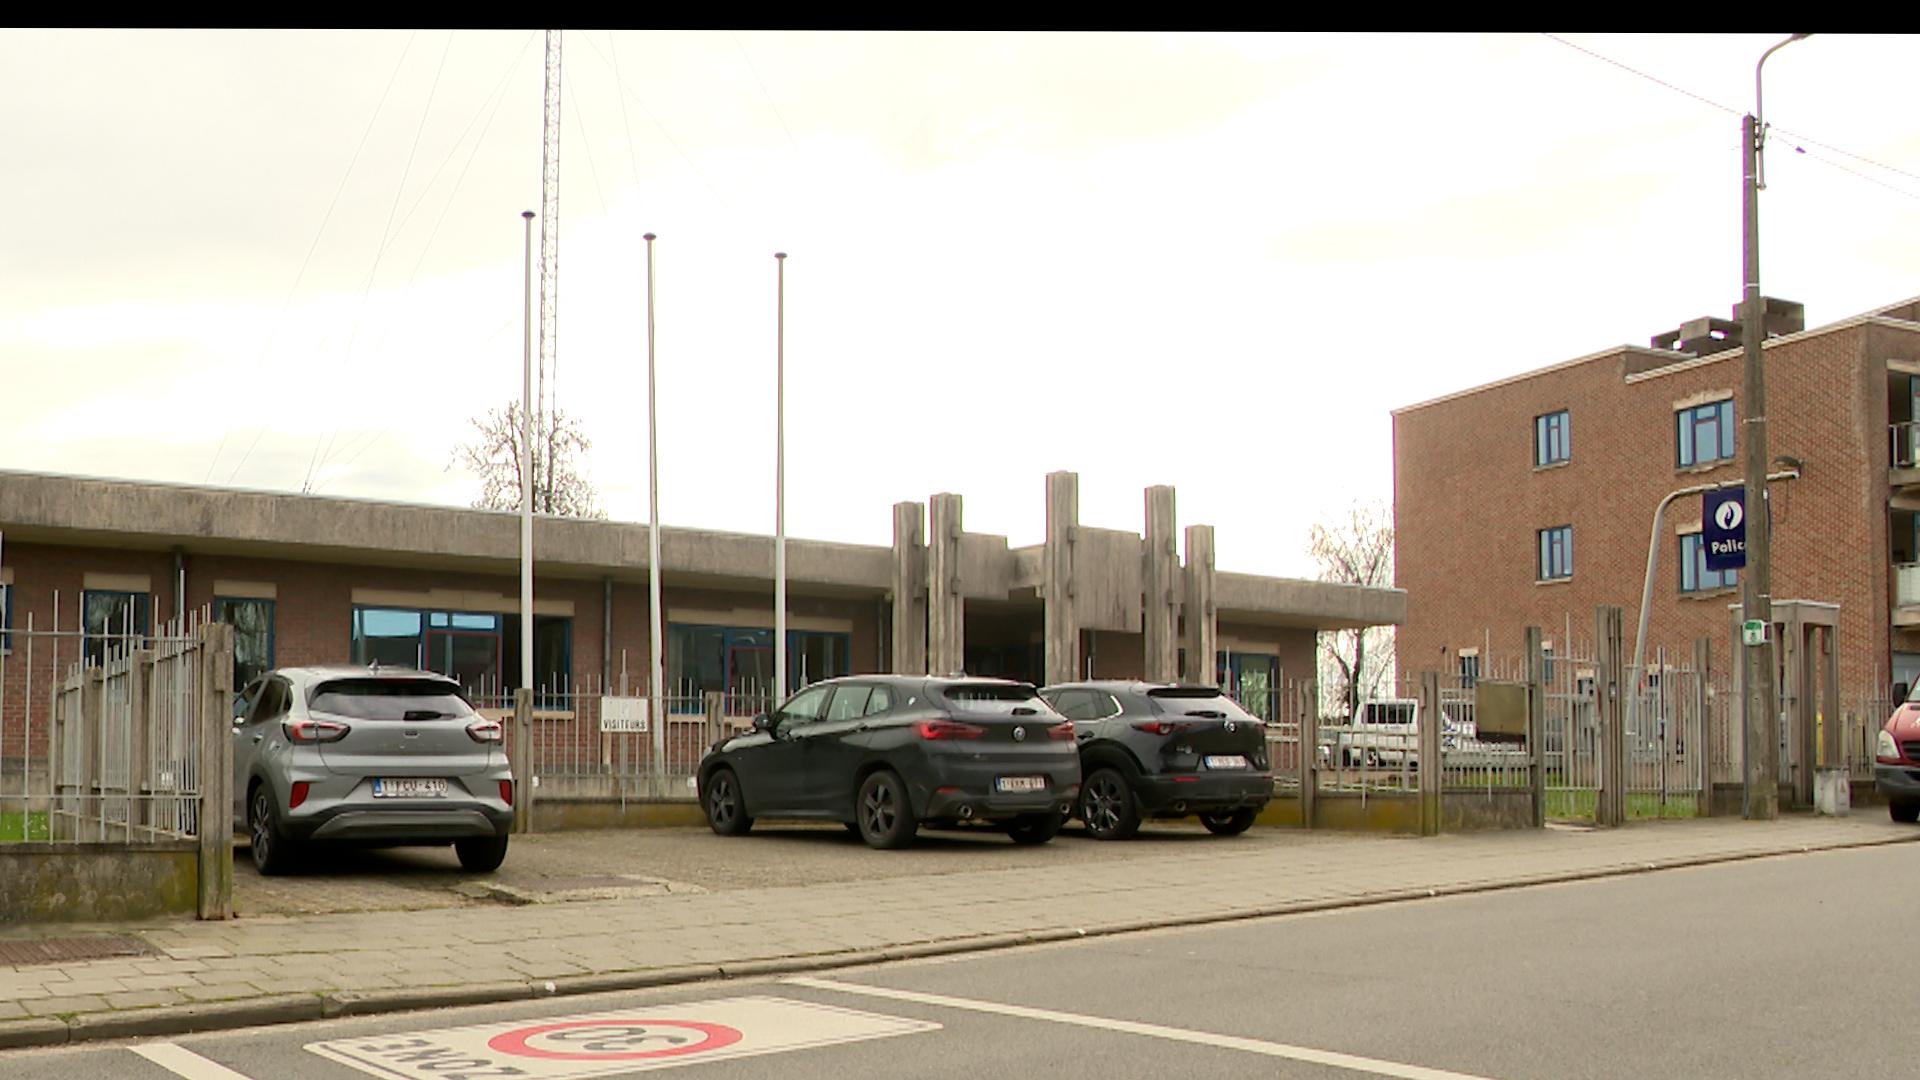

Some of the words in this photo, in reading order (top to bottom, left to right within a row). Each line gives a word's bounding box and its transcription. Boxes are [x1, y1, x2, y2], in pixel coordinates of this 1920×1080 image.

[1711, 539, 1745, 555] Polic
[603, 719, 646, 729] VISITEURS
[545, 1027, 688, 1051] 30
[358, 1039, 530, 1079] ZONE
